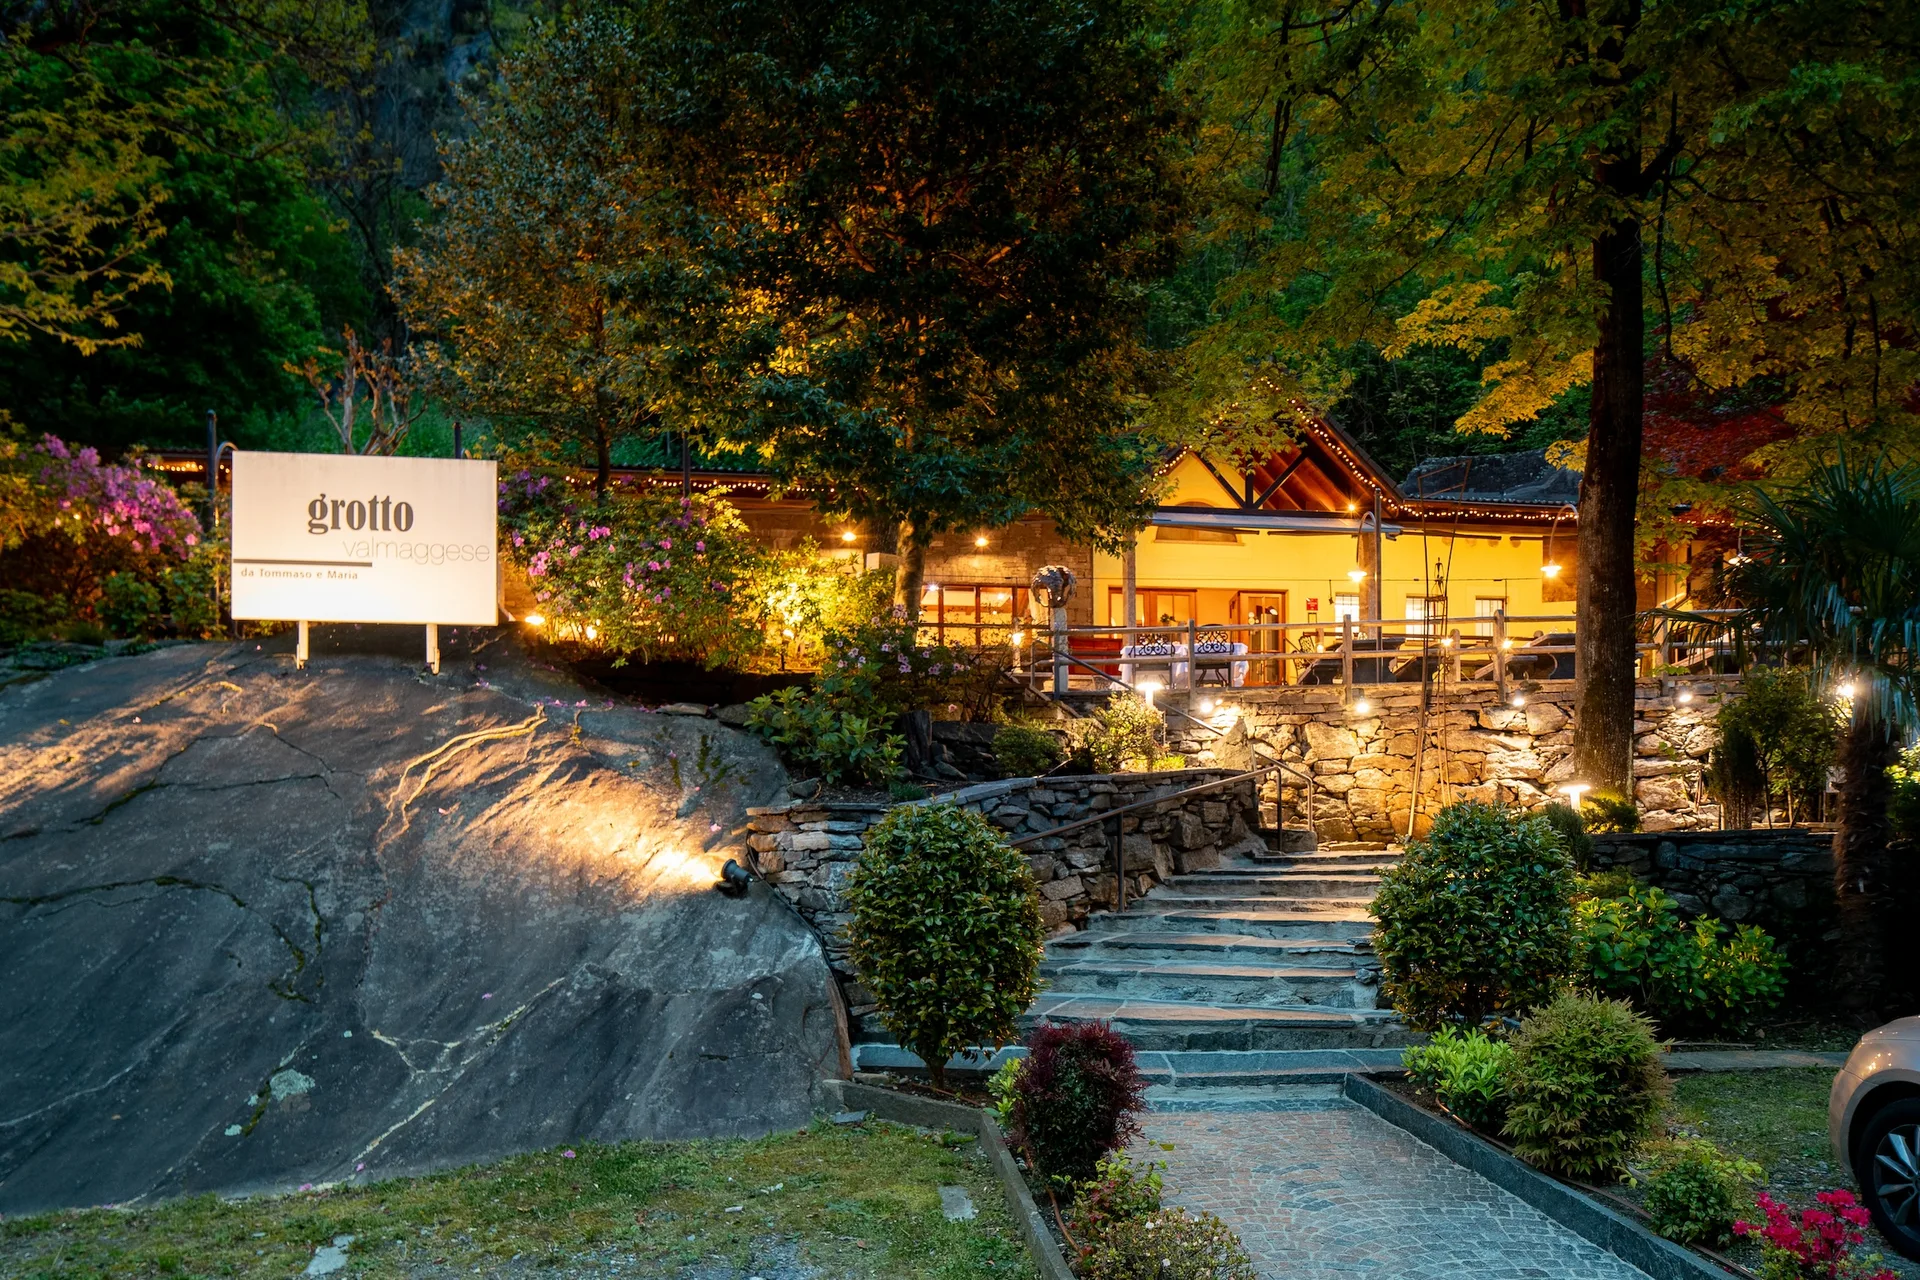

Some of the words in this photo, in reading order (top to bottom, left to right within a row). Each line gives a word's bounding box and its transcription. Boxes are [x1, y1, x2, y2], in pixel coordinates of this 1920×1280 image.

[307, 493, 414, 535] grotto
[342, 536, 491, 566] valmaggese
[240, 567, 254, 578] da
[260, 568, 312, 579] Tommaso
[316, 571, 323, 579] e
[327, 570, 359, 580] Maria
